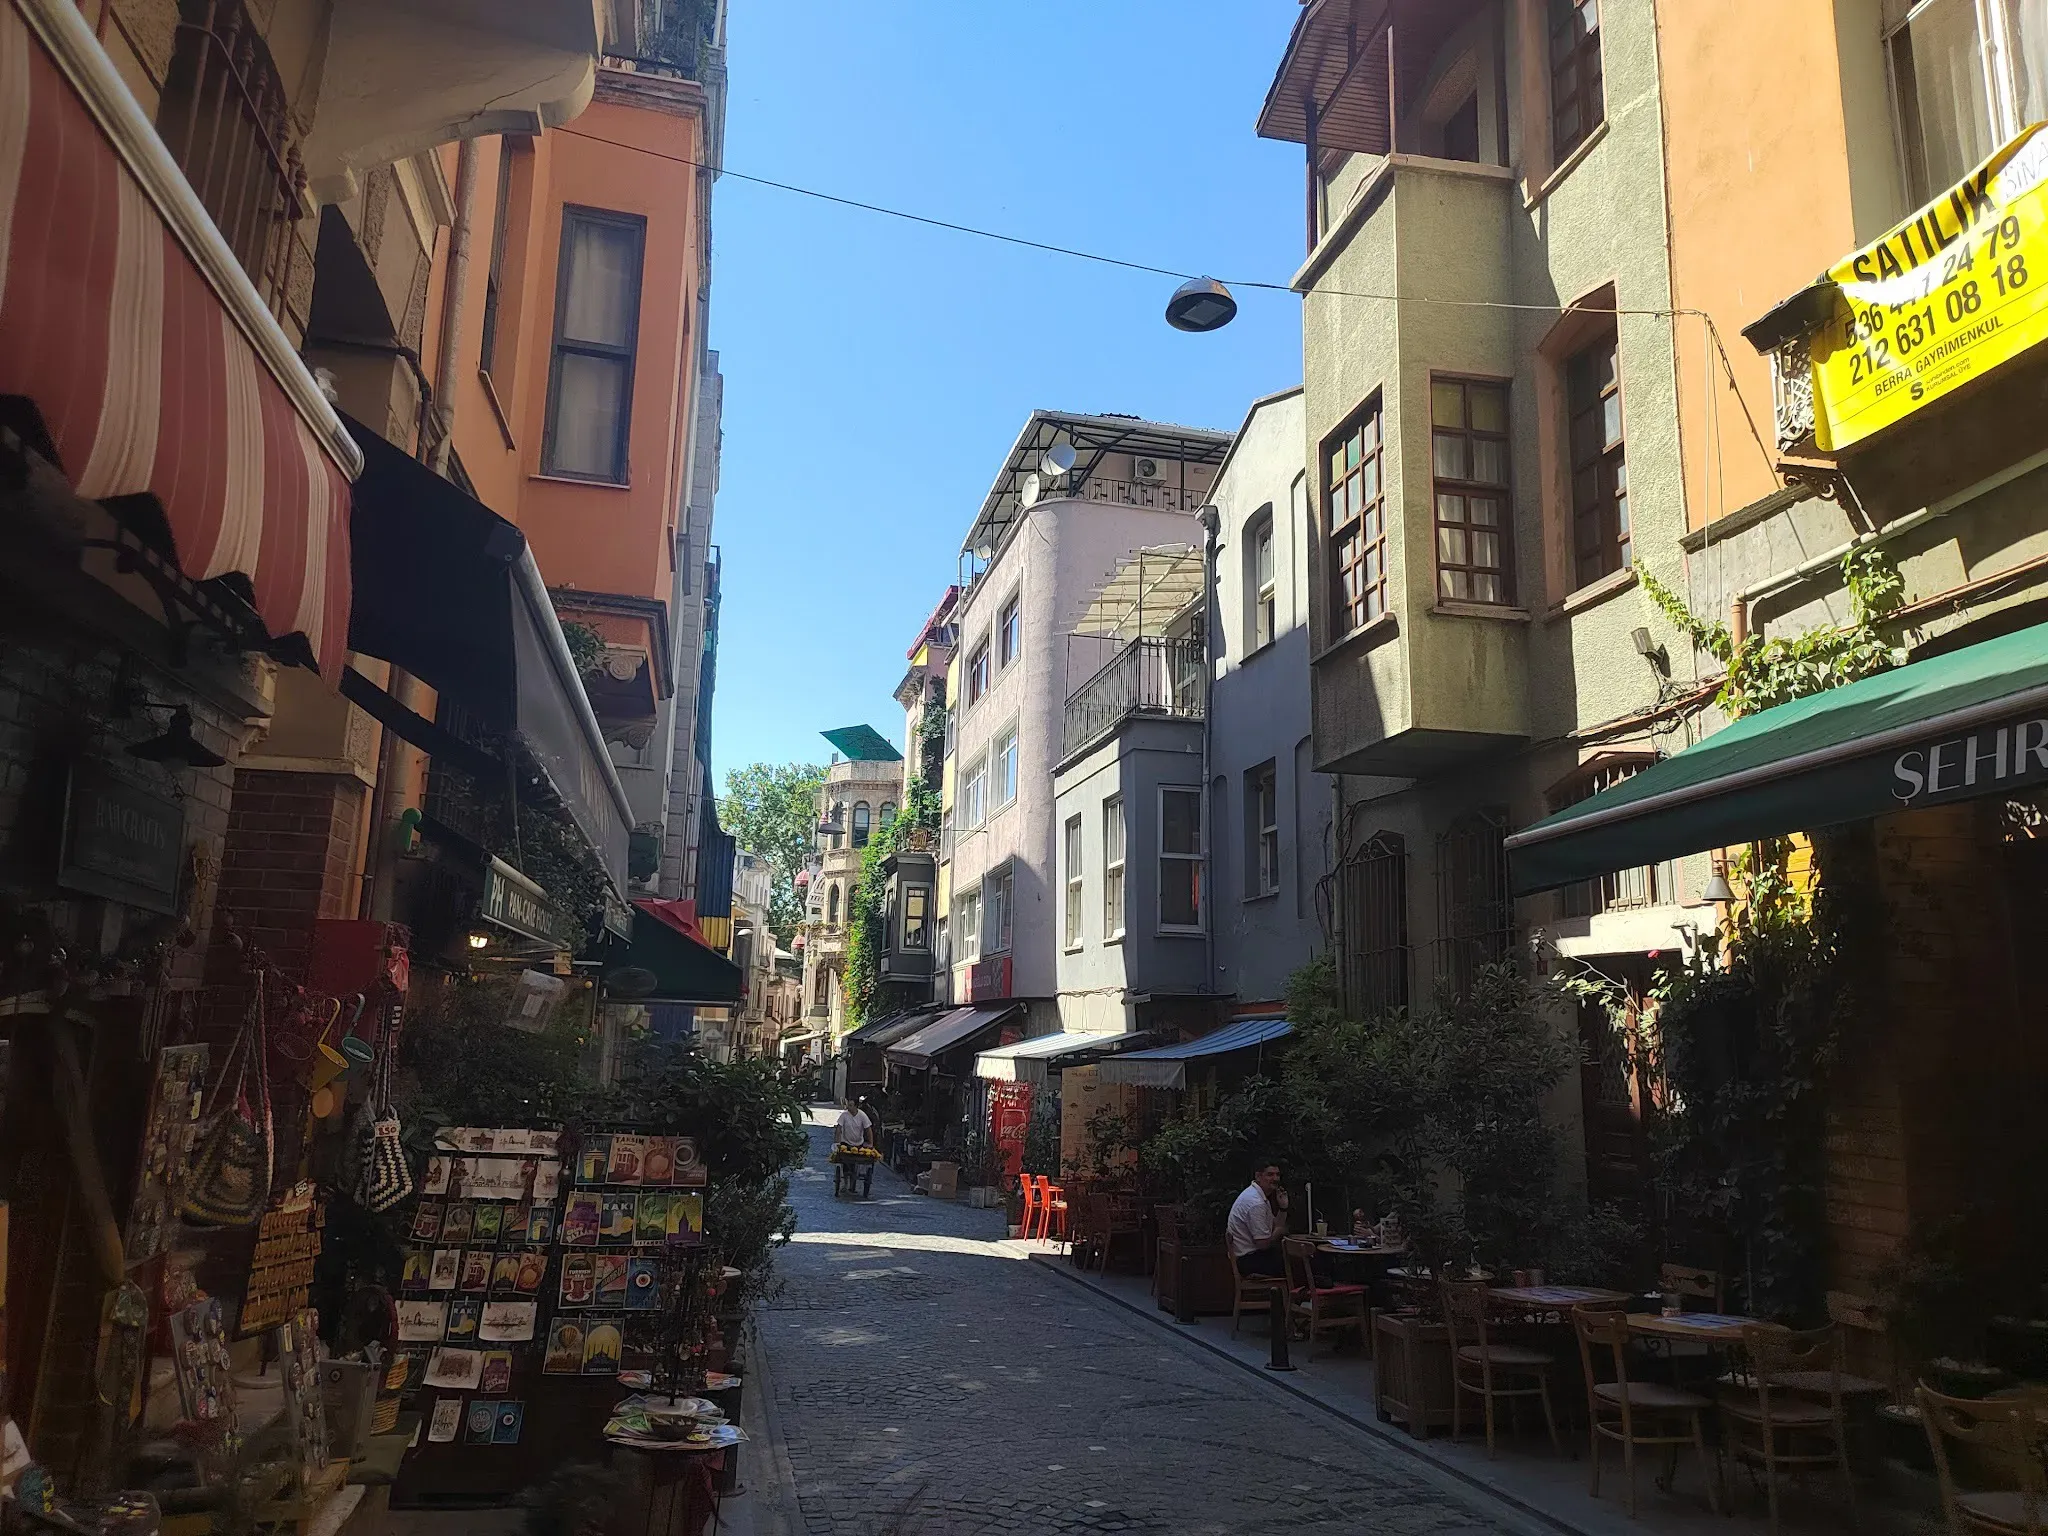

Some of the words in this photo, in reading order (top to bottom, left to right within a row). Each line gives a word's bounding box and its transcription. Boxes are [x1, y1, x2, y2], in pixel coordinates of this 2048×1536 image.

[1853, 167, 1997, 287] SATILIK
[1845, 304, 1883, 349] 536
[1942, 242, 1974, 285] 24
[1982, 215, 2020, 260] 79
[1849, 337, 1890, 386] 212
[1895, 305, 1936, 355] 631
[1945, 281, 1981, 323] 08
[1992, 254, 2028, 298] 18
[1874, 366, 1912, 397] BERRA
[1915, 315, 2004, 379] GAYRİMENKUL
[1891, 719, 2048, 807] ŞEHR
[489, 873, 506, 919] PH
[508, 890, 537, 928] PAN-CAKE
[536, 908, 553, 935] HOUSE
[615, 1136, 645, 1147] TAKSIM
[603, 1202, 634, 1211] RAKI
